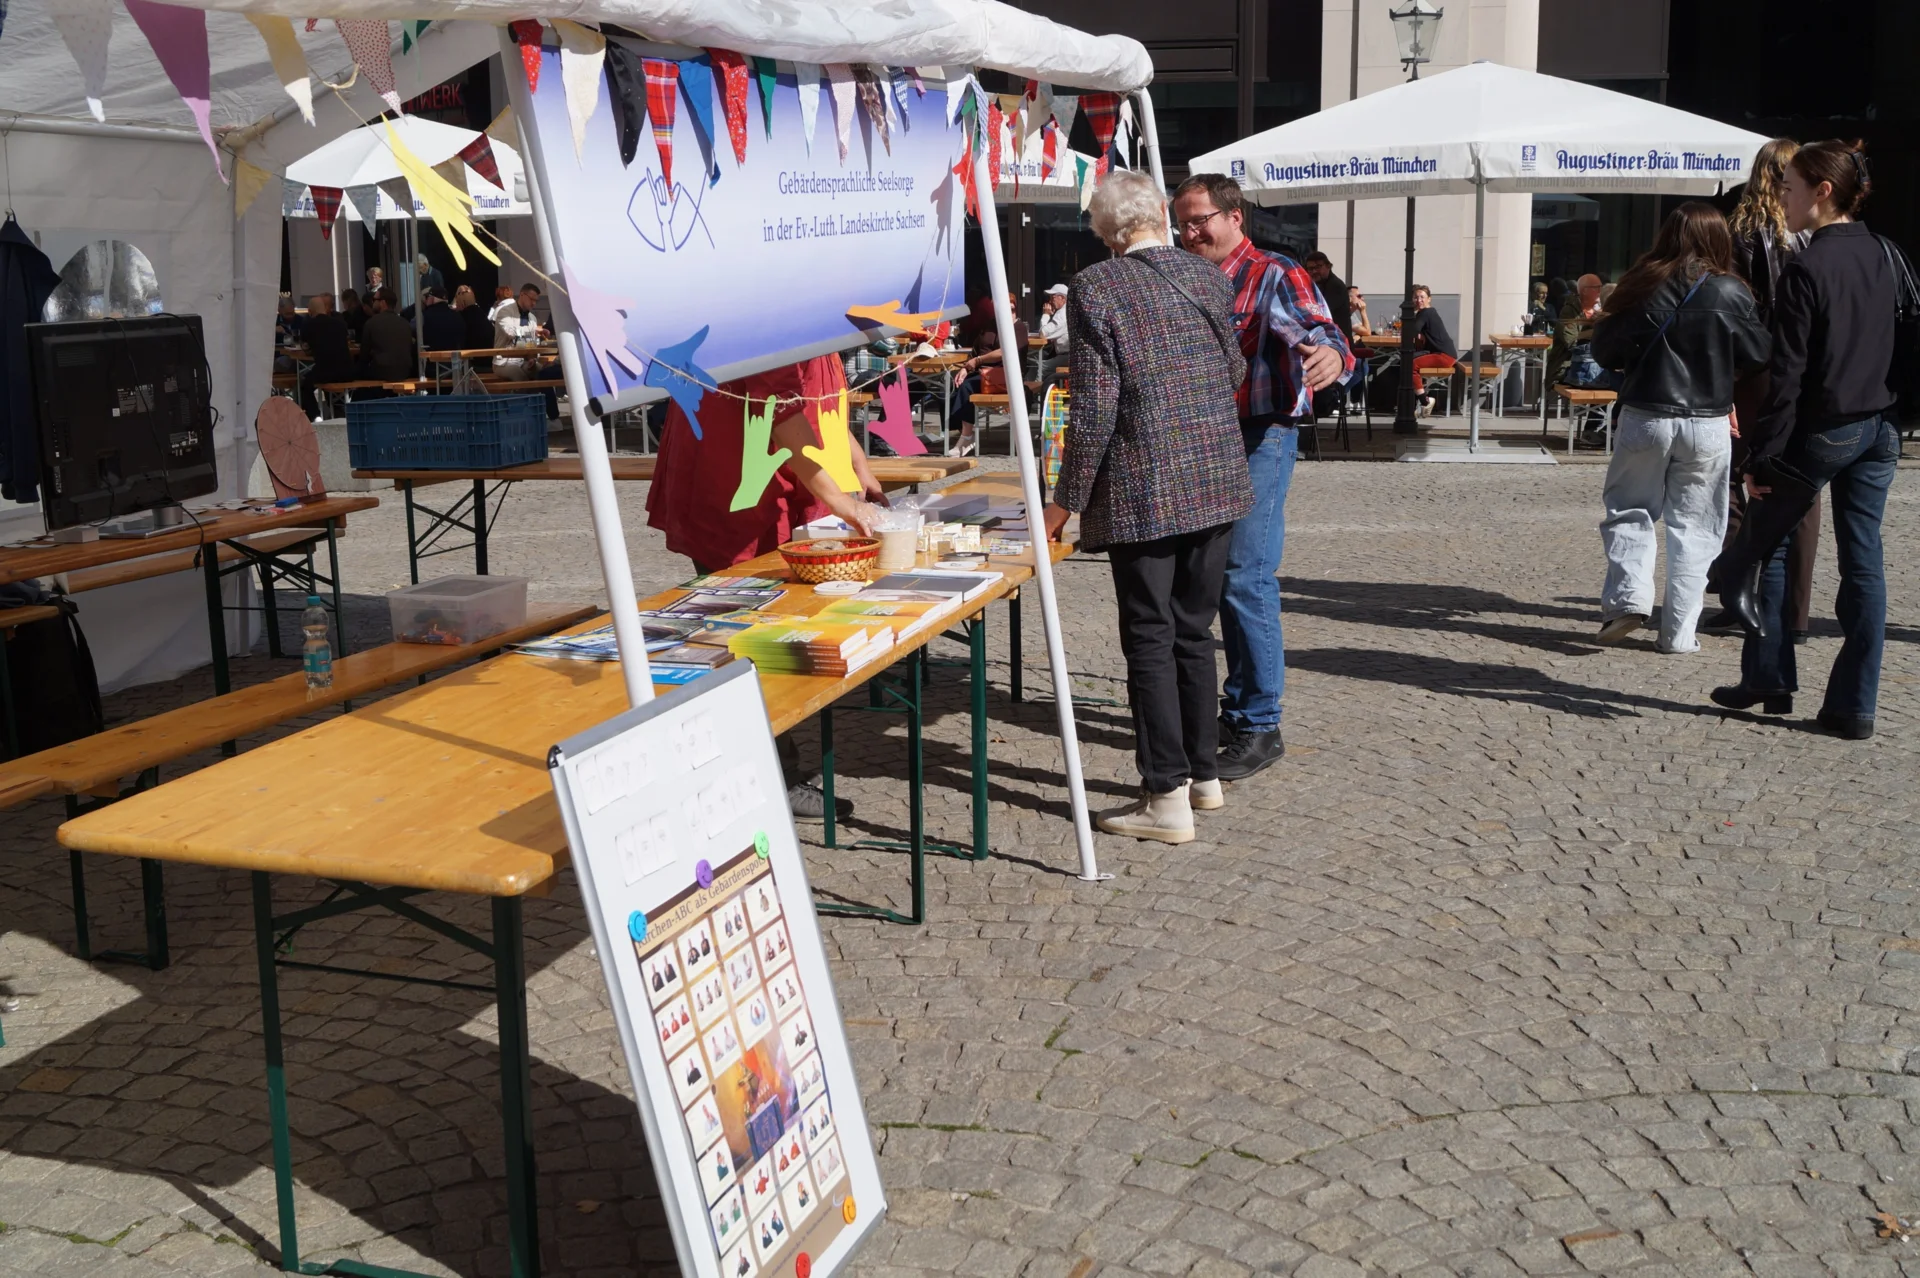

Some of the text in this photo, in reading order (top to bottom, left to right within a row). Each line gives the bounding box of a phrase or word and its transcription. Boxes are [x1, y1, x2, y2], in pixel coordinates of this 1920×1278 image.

[1381, 156, 1437, 174] München
[1682, 152, 1741, 171] München
[778, 171, 914, 200] Gebärdensprachliche Seelsorge
[473, 195, 510, 209] München
[763, 209, 925, 242] in der Ev.-Luth. Landeskirche Sachsen
[695, 897, 708, 910] als
